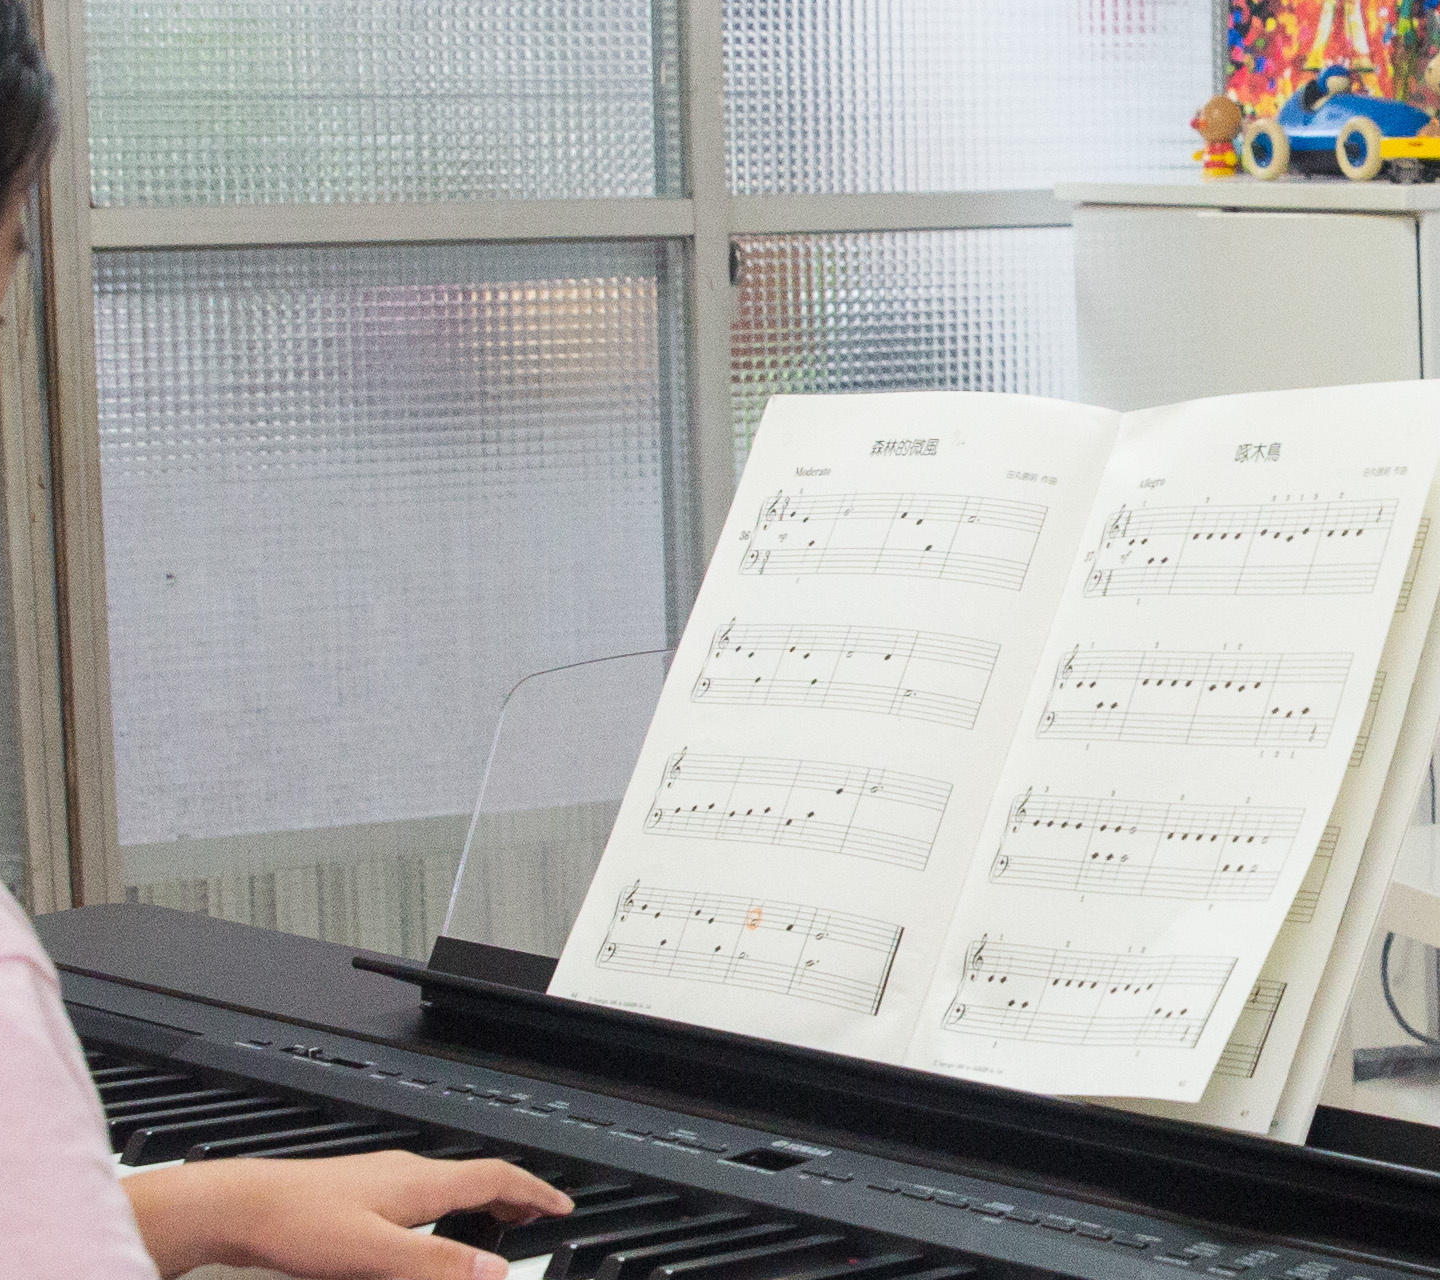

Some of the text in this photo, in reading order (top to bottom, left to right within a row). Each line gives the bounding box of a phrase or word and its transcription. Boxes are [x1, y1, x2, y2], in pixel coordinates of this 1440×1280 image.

[870, 438, 940, 457] 森林的微風
[1234, 441, 1282, 463] 啄木鳥
